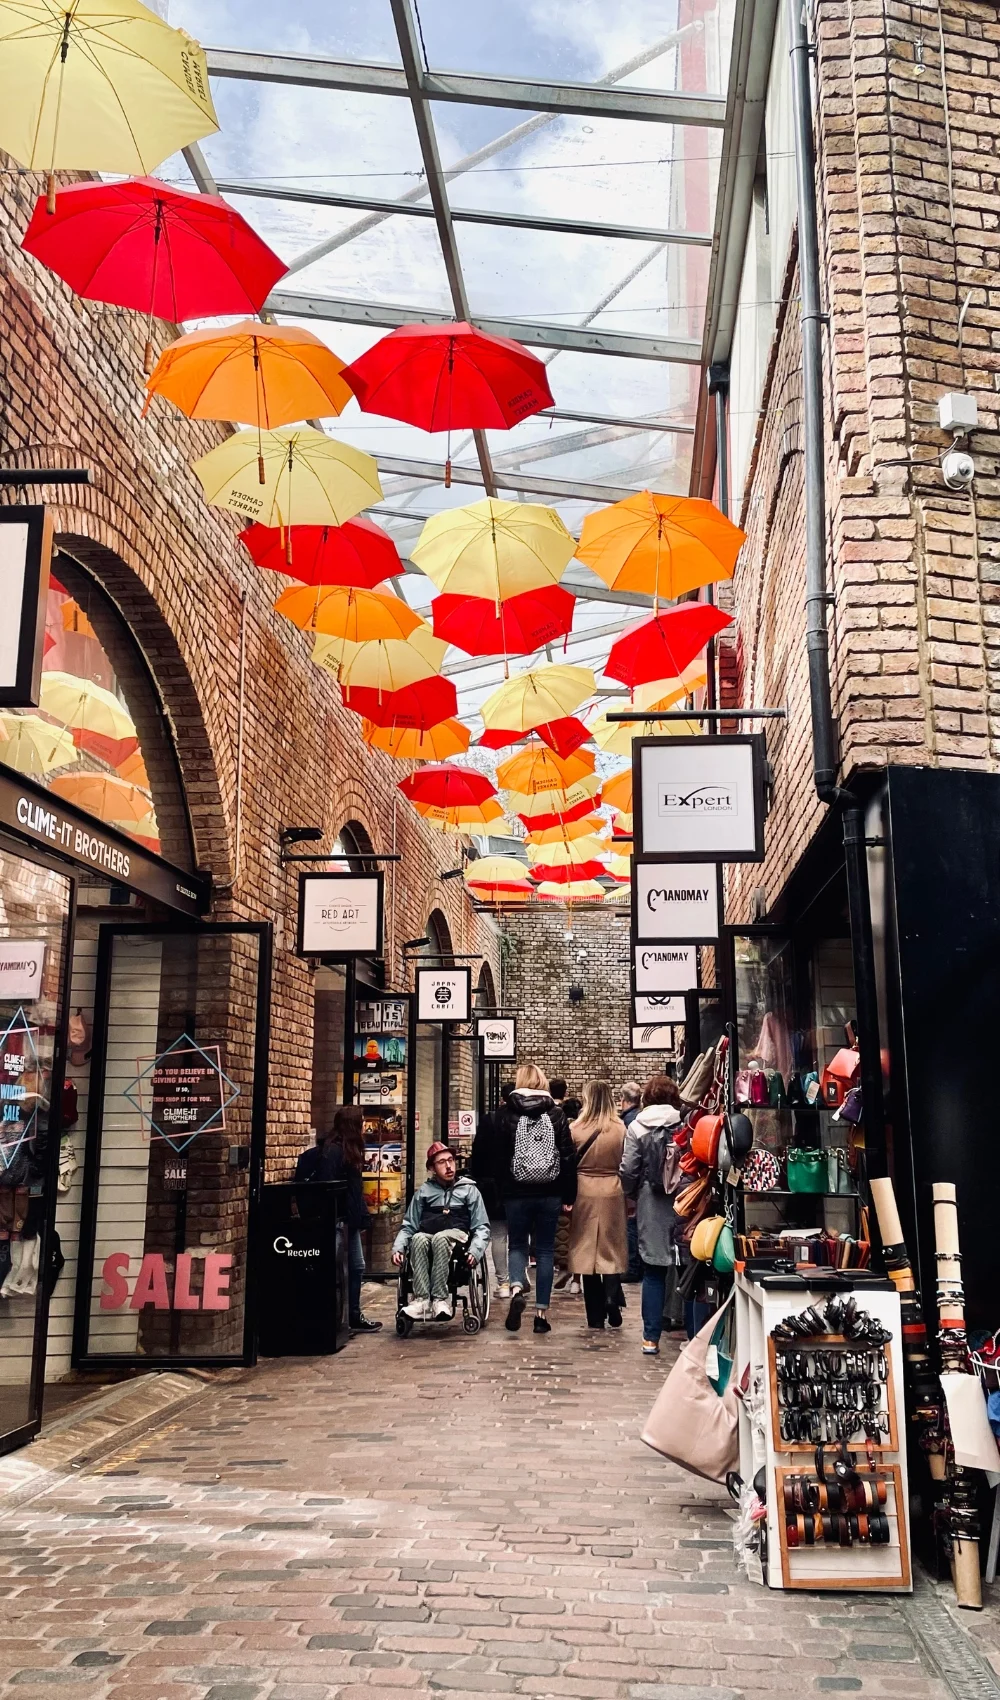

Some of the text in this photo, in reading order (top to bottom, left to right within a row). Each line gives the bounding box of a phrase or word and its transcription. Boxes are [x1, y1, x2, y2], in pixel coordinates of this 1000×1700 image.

[663, 793, 732, 809] Expert
[16, 797, 130, 878] CLIME-IT BROTHERS
[646, 888, 709, 913] MANOMAY
[321, 909, 359, 919] RED ART
[641, 951, 689, 970] MANOMAY
[386, 1011, 399, 1020] IS
[152, 1076, 200, 1084] GIVING BACK?
[3, 1104, 20, 1121] SALE
[163, 1108, 198, 1116] CLIME-IT
[164, 1169, 187, 1179] SALE
[287, 1248, 320, 1258] Recycle
[99, 1252, 233, 1310] SALE
